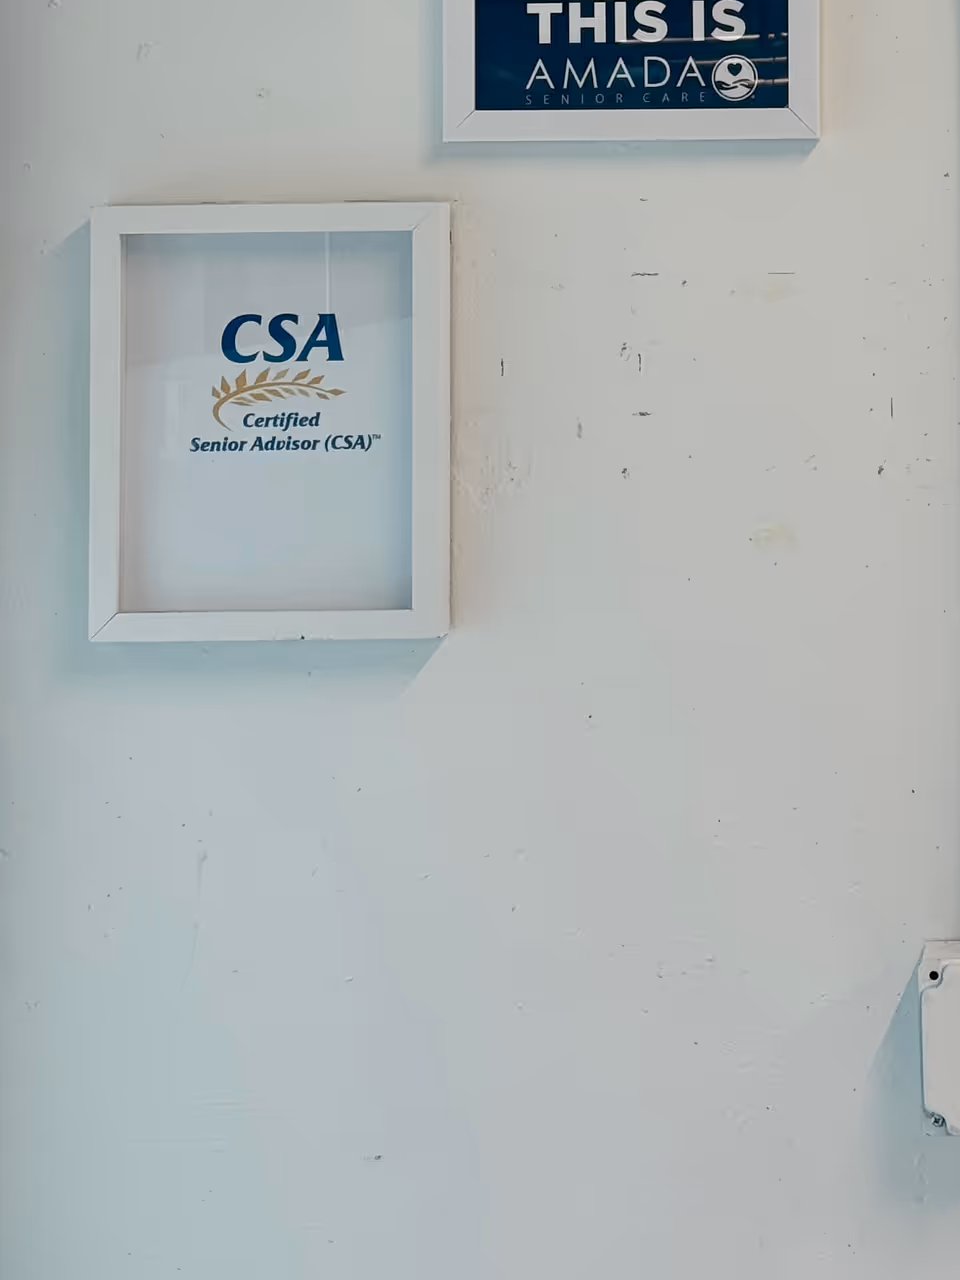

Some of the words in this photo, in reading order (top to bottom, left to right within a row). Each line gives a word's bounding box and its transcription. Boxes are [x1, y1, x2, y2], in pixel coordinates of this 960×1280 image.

[526, 0, 668, 44] THIS
[692, 0, 746, 42] IS
[525, 56, 706, 90] AMADA
[526, 93, 623, 105] SENIOR
[642, 92, 706, 103] CARE
[221, 313, 345, 363] CSA
[243, 412, 321, 431] Certified
[190, 437, 248, 452] Senior
[250, 436, 320, 451] Advisor
